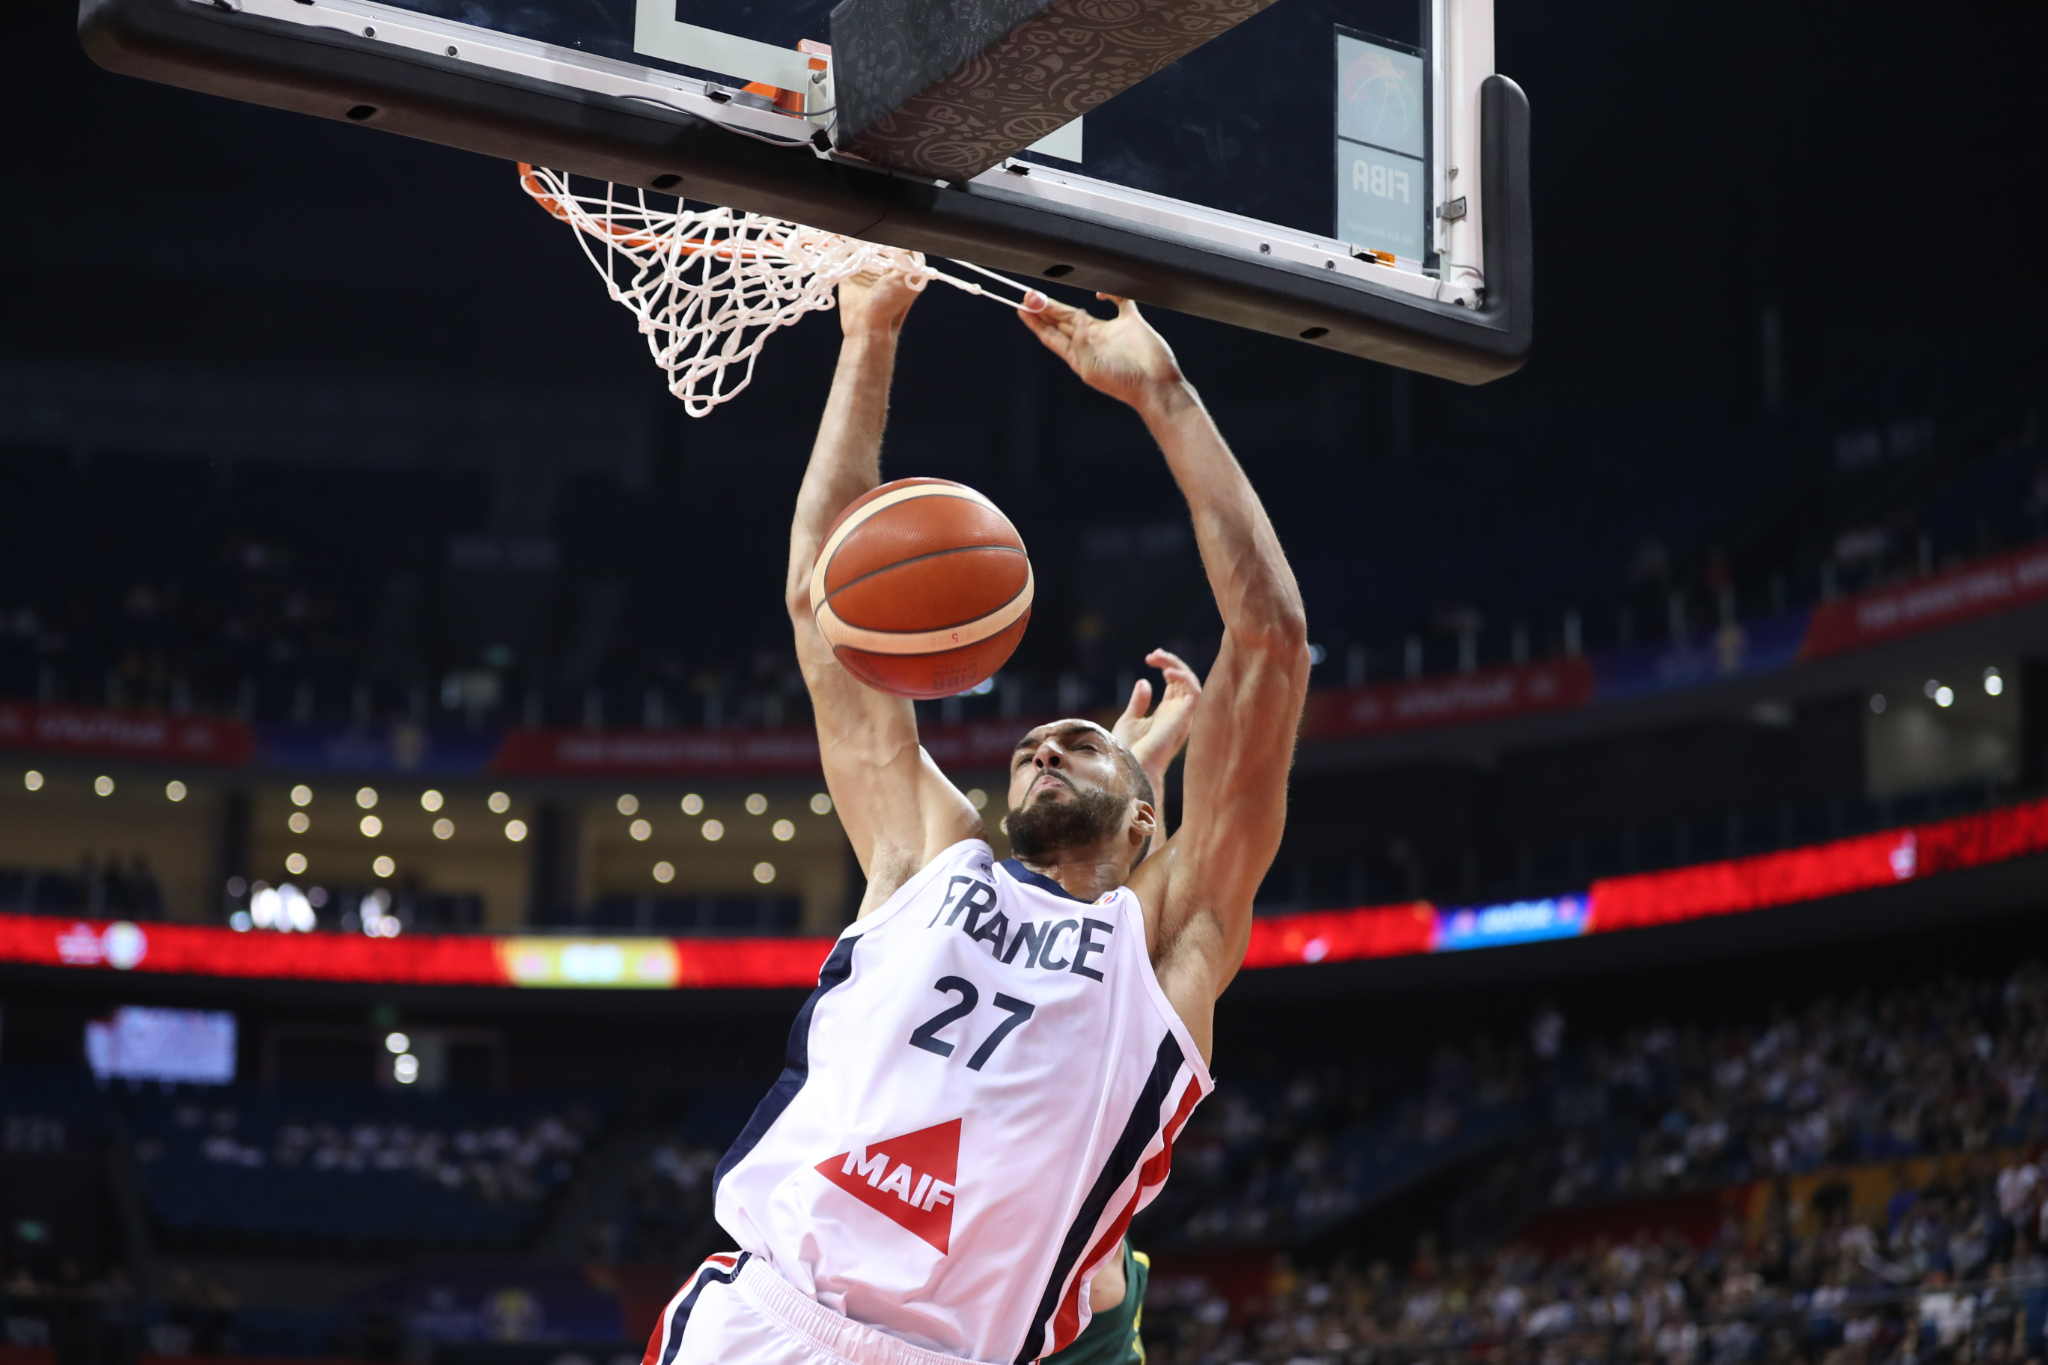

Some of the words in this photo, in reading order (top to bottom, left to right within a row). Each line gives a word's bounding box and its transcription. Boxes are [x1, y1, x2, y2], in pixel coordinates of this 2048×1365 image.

[927, 875, 1115, 983] FRANCE
[908, 975, 1036, 1072] 27
[841, 1145, 954, 1213] MAIF
